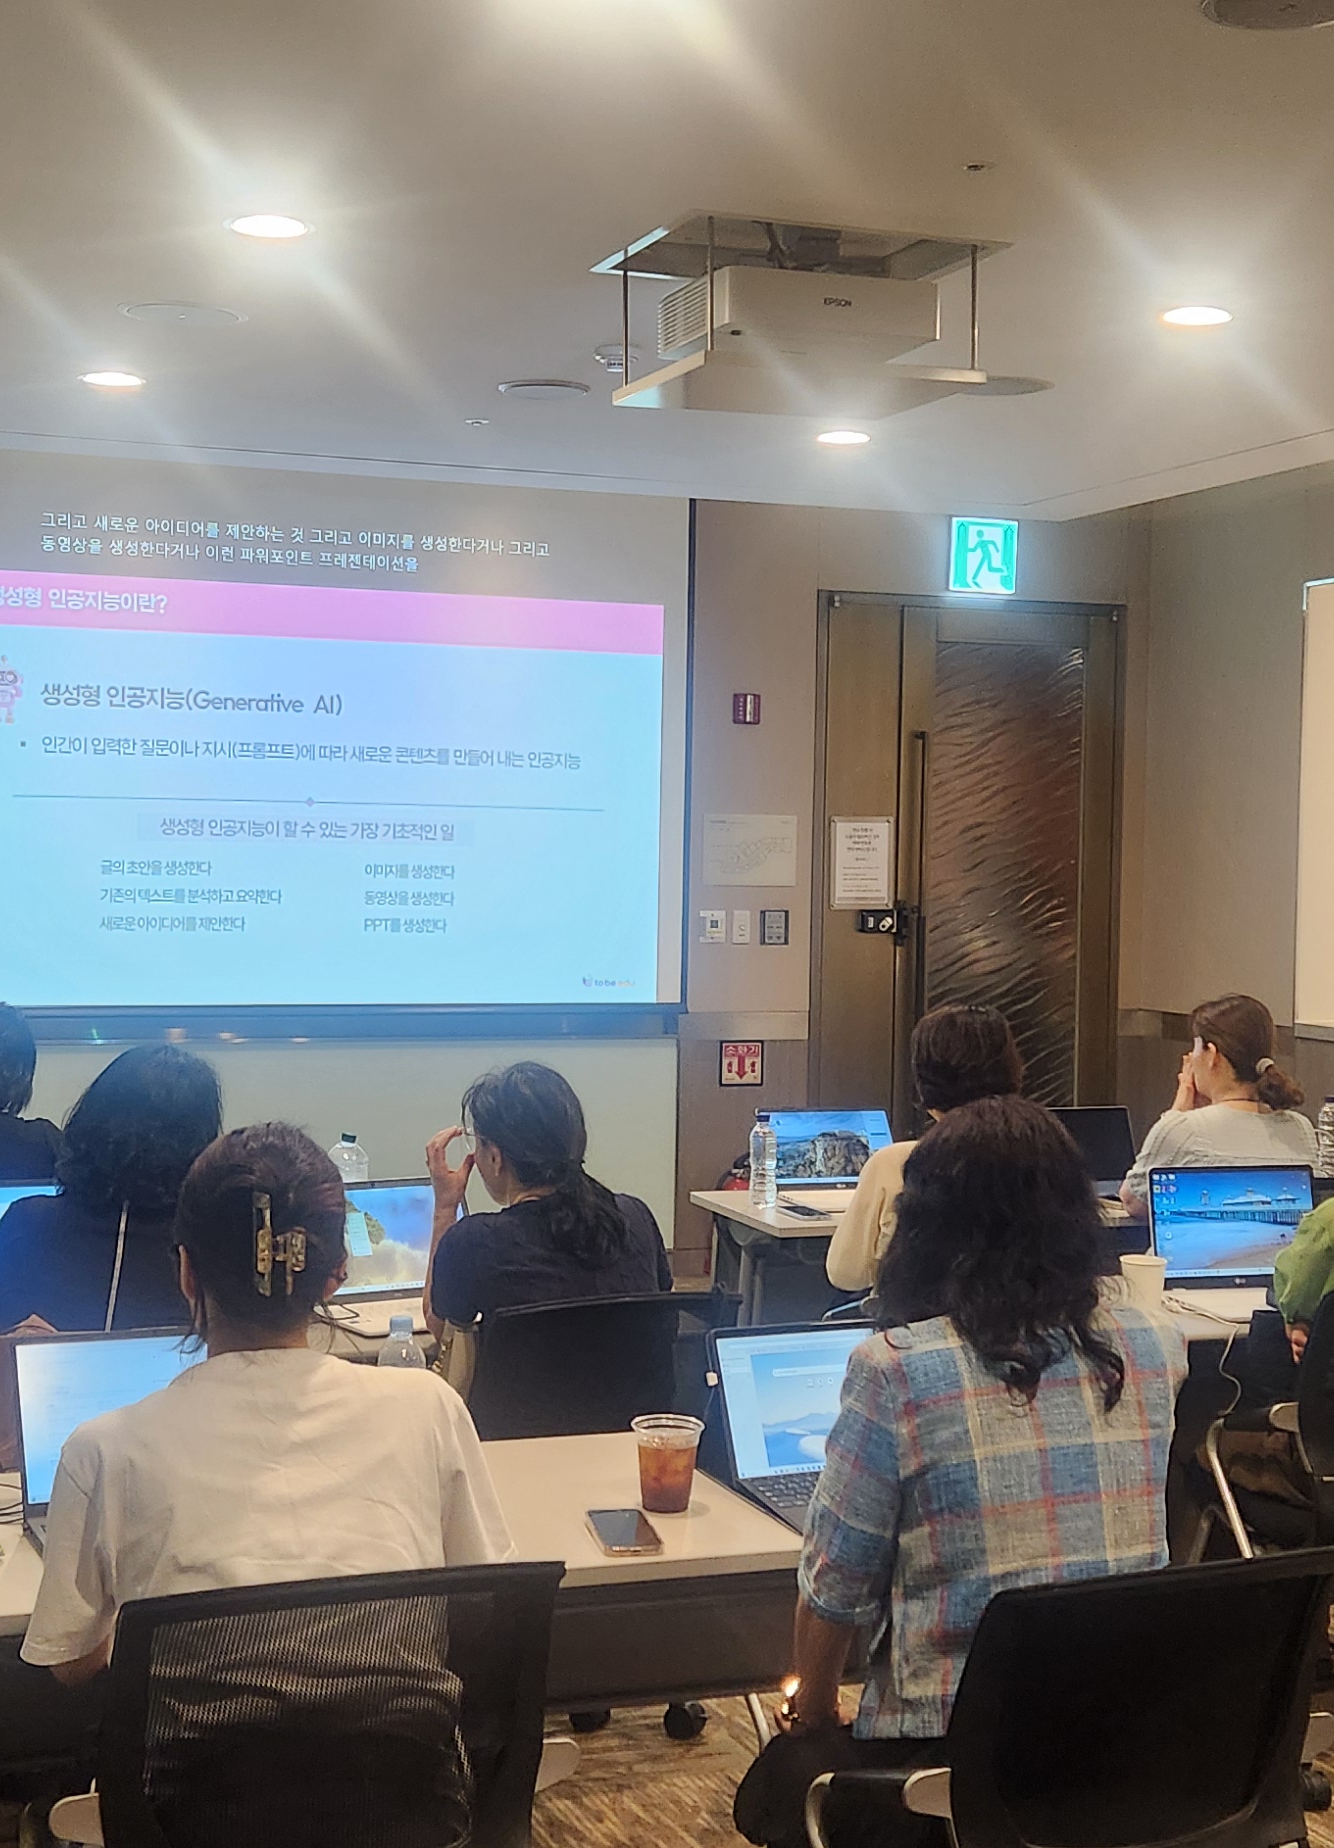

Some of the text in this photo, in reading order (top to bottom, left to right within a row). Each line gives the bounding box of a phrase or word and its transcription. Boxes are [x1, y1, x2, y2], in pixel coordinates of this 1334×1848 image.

[824, 297, 852, 307] EPSON
[40, 512, 549, 557] 그리고 새로운 아이디어를 제안하는 것 그리고 이미지를 생성한다거나 그리고
[41, 535, 418, 573] 동영상을 생성한다거나 이런 파워포인트 프레젠테이션을
[48, 588, 167, 613] 인공지능이란?
[41, 684, 342, 716] 생성형 인공지능(Generative AI)
[42, 736, 581, 770] 인간이 입력한 질문이나 지시(프롬프트)에 따라 새로운 콘텐츠를 만들어 내는 인공지능
[160, 818, 454, 841] 생성형 인공지능이 할 수 있는 가장 기초적인 일
[100, 860, 212, 876] 글의 초안을 생성한다
[411, 864, 454, 880] 생성한다
[100, 888, 136, 903] 기존의
[188, 889, 234, 904] 분석하고
[236, 889, 282, 904] 요약한다
[364, 891, 454, 906] 동영상을 생성한다
[100, 917, 136, 931] 새로운
[198, 917, 245, 931] 제안한다
[403, 918, 447, 933] 생성한다
[726, 1045, 758, 1056] 소화기
